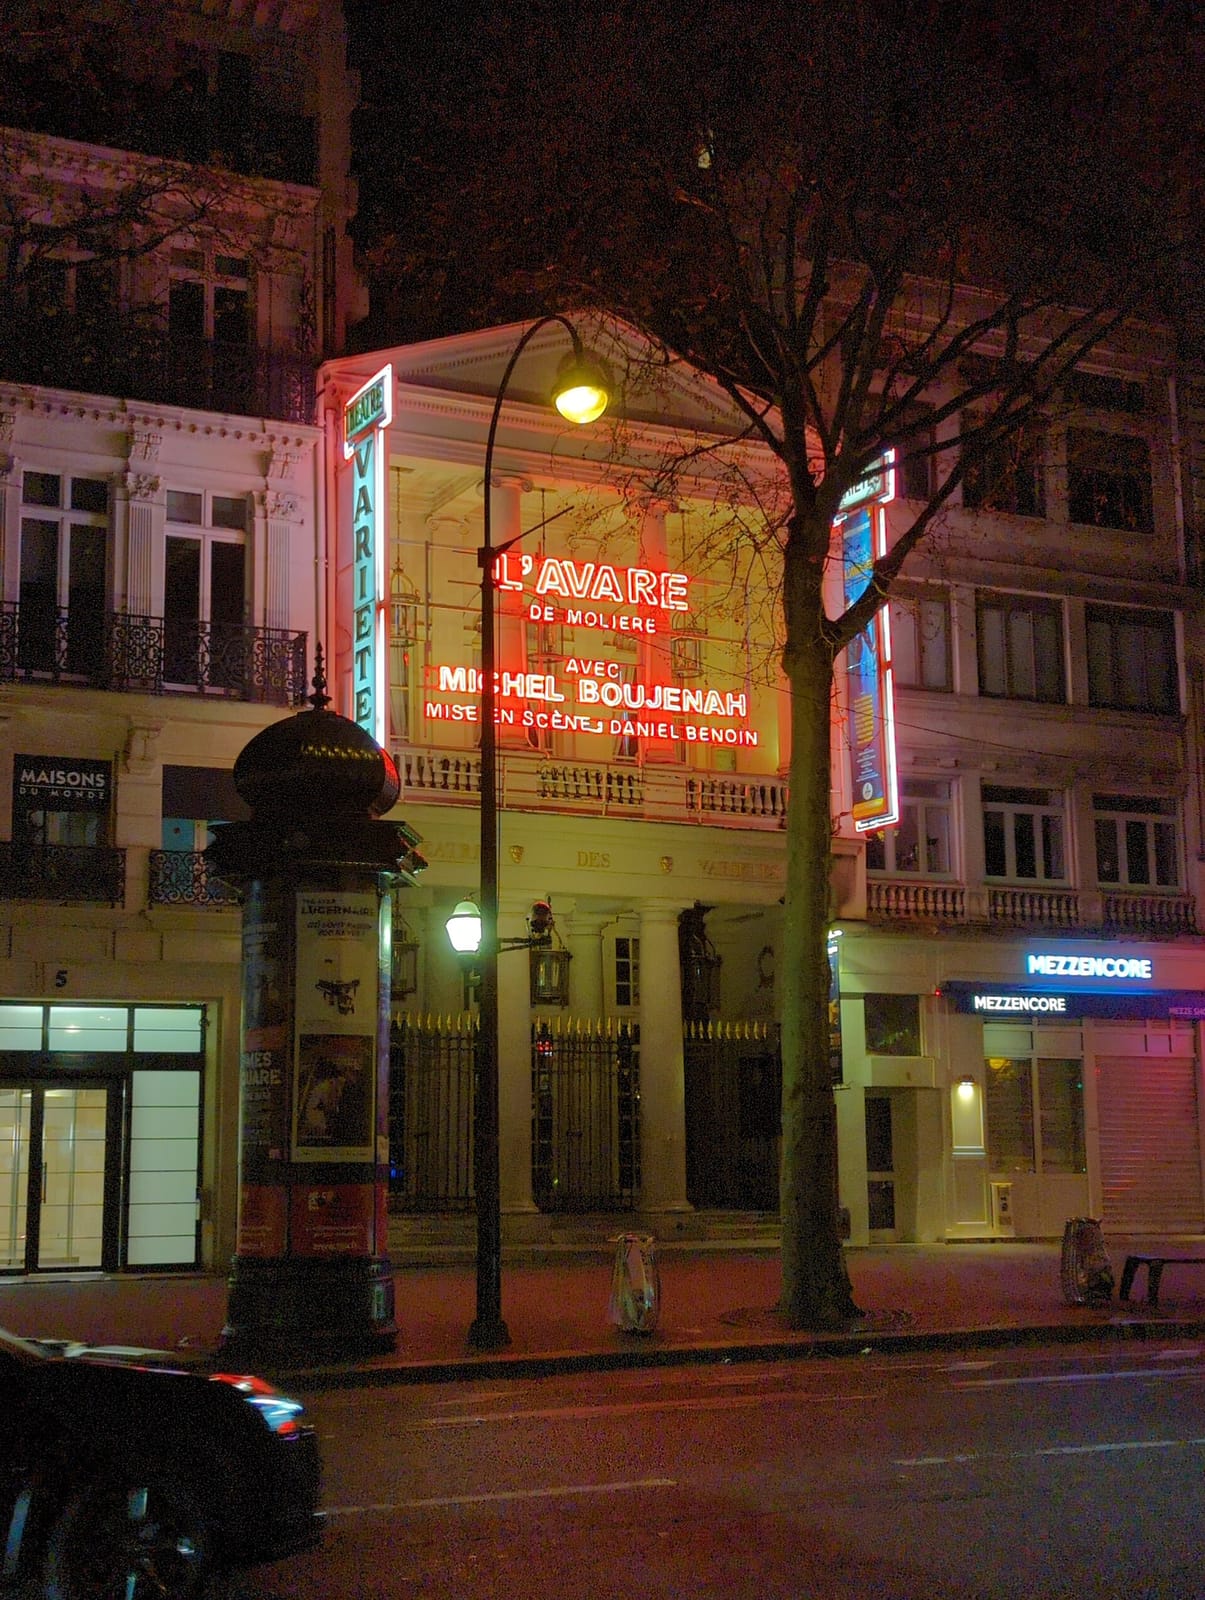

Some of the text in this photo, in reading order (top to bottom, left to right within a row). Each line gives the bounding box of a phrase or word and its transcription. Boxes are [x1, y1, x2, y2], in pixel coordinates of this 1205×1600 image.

[352, 439, 374, 737] VARIETE
[493, 553, 689, 611] L'AVARE
[530, 604, 656, 634] DE MOLIERE
[566, 658, 619, 678] AVEC
[579, 678, 747, 717] BOUJENAH
[426, 703, 478, 721] MISE
[610, 719, 679, 739] DANIEL
[686, 725, 758, 745] BENOIN
[20, 768, 105, 788] MAISONS
[20, 787, 105, 800] DU MONDE
[577, 851, 611, 868] DES
[1027, 954, 1152, 979] MEZZENCORE
[55, 969, 68, 987] 5
[974, 995, 1067, 1012] MEZZENCORE
